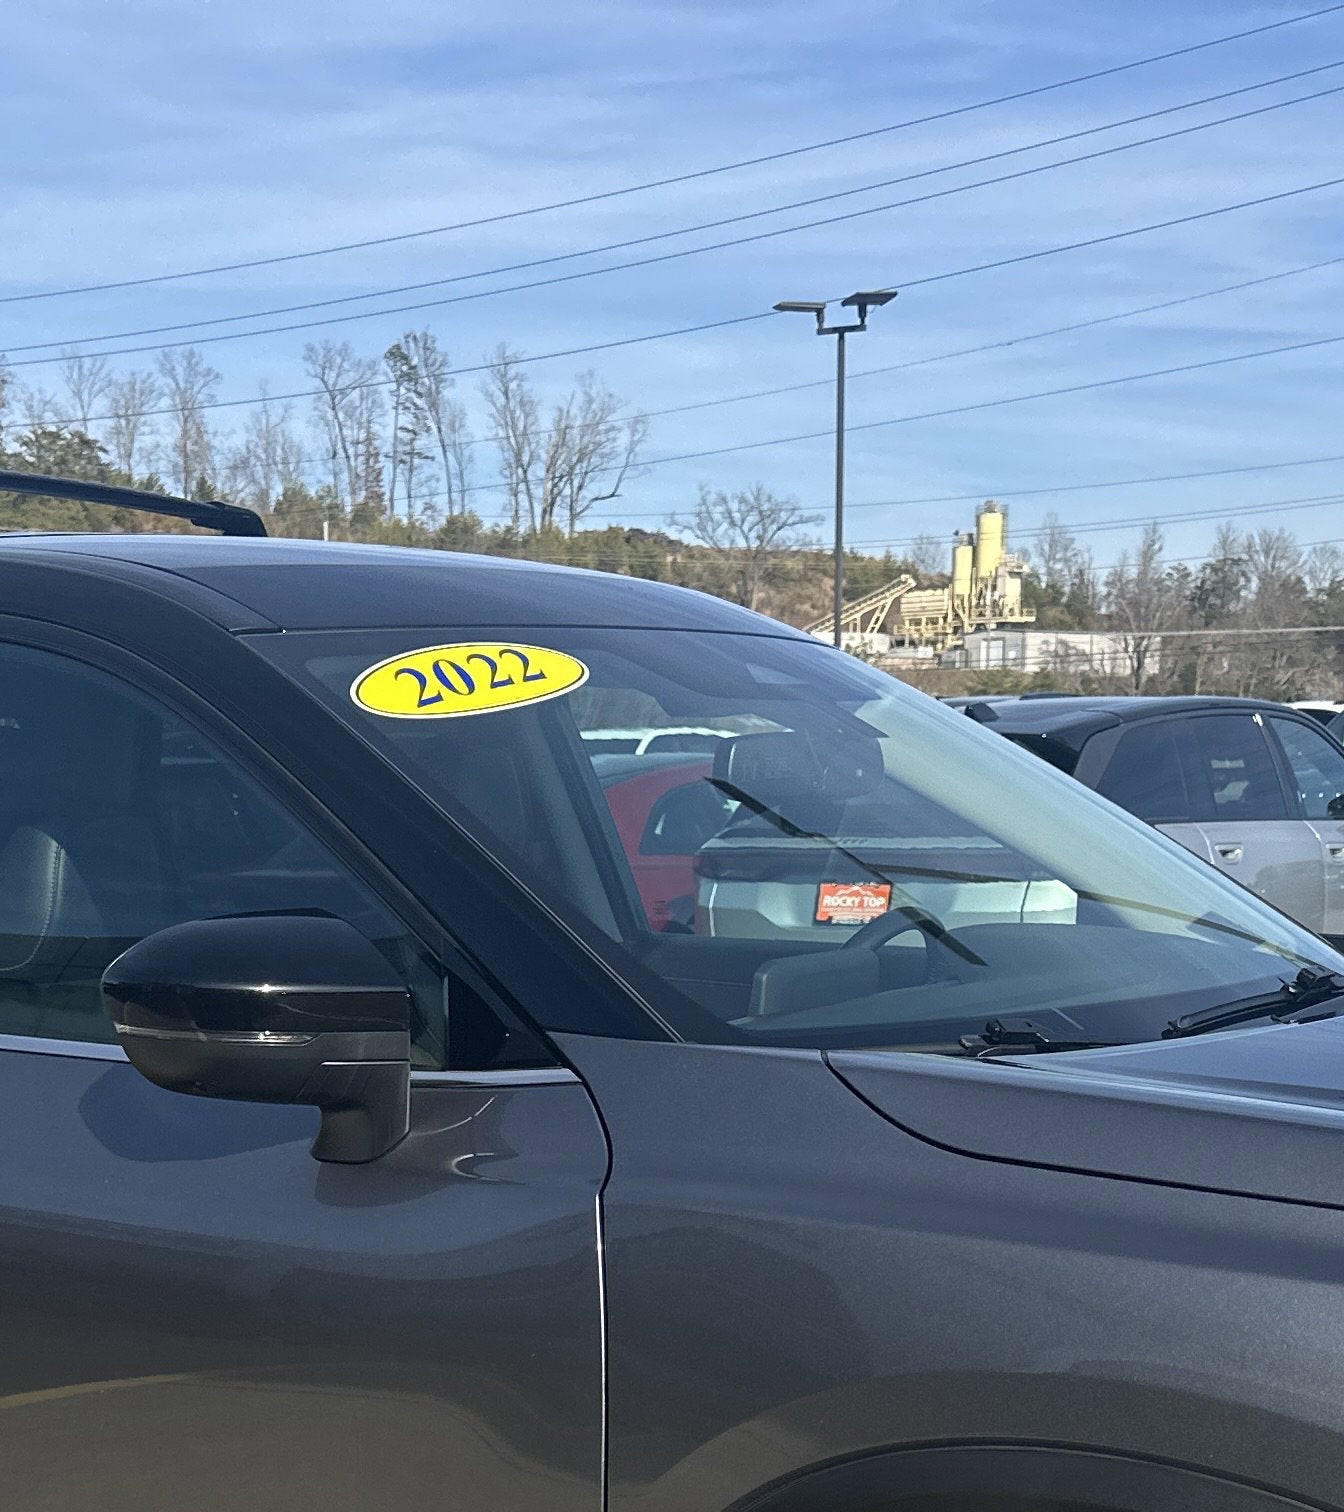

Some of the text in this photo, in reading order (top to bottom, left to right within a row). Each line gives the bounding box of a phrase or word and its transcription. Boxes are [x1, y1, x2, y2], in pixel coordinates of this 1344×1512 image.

[394, 648, 547, 708] 2022
[822, 895, 886, 908] ROCKY TOP
